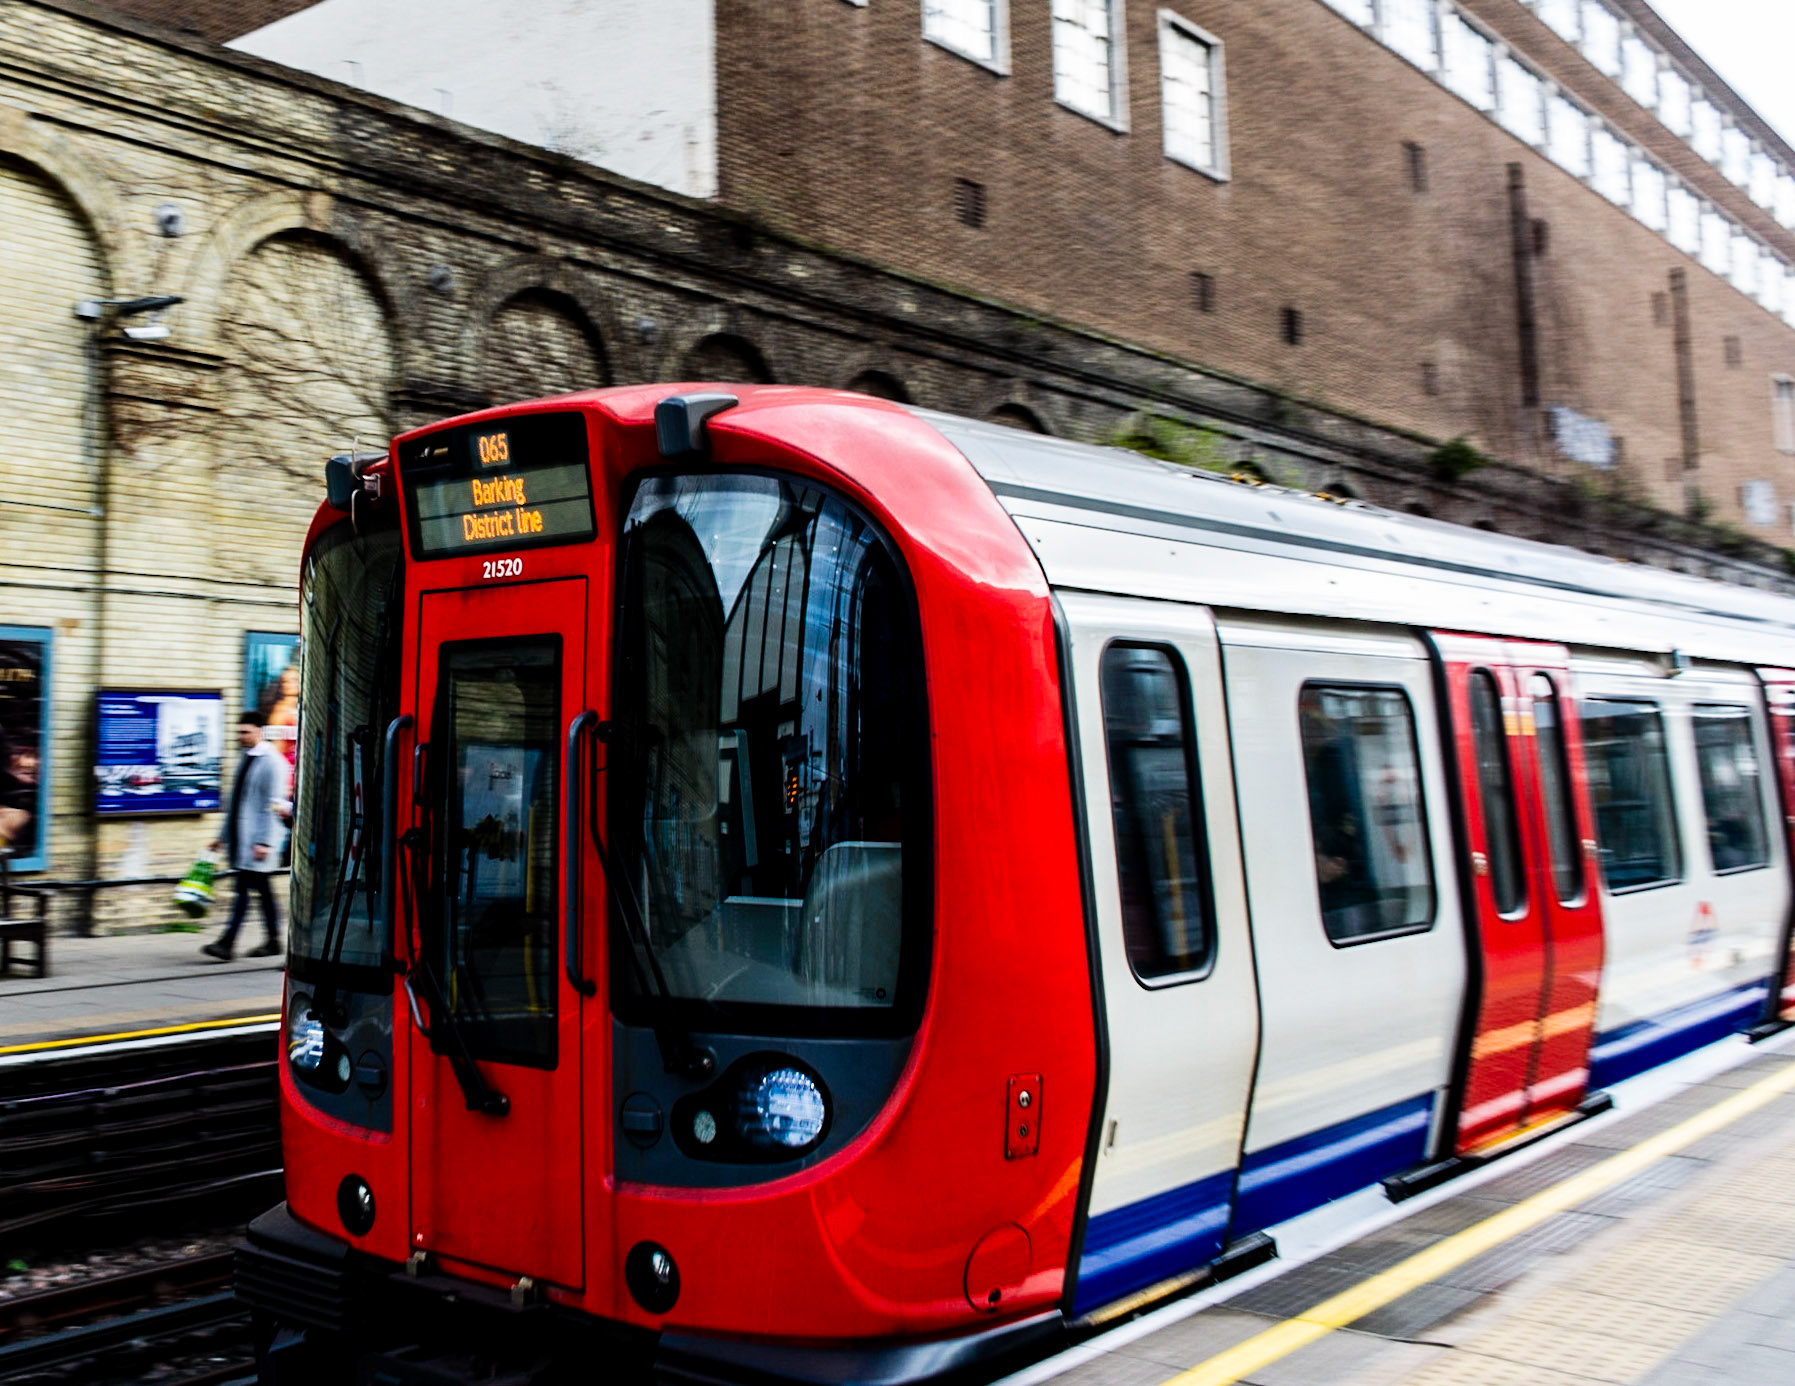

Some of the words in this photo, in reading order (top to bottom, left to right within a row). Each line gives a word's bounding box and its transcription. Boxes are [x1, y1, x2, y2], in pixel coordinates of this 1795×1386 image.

[478, 433, 509, 463] 065
[471, 475, 526, 506] Barking
[462, 511, 514, 541] District
[515, 507, 543, 534] line
[482, 557, 523, 578] 21520
